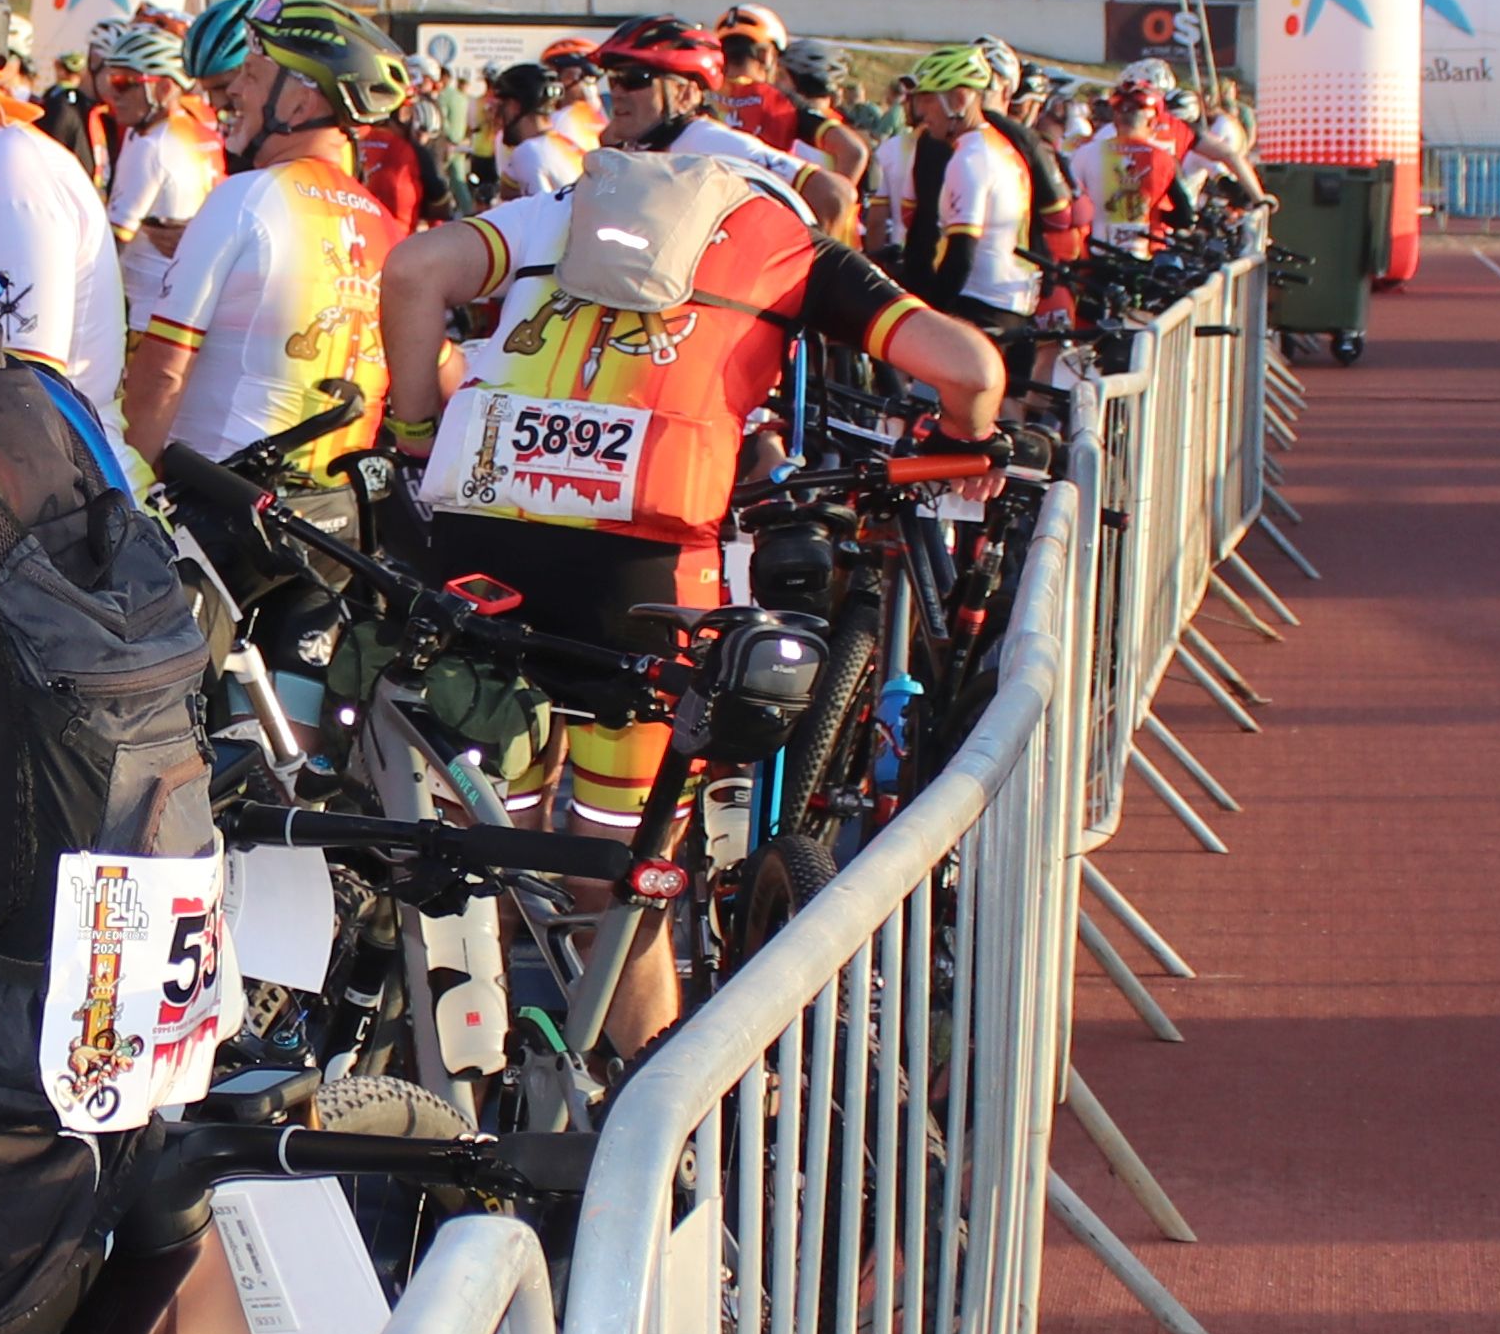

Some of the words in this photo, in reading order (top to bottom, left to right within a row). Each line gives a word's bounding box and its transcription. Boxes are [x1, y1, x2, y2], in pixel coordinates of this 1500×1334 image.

[1143, 9, 1202, 46] OS
[1424, 57, 1493, 83] aBank
[294, 182, 324, 199] LA
[511, 408, 635, 464] 5892
[92, 943, 122, 955] 2024
